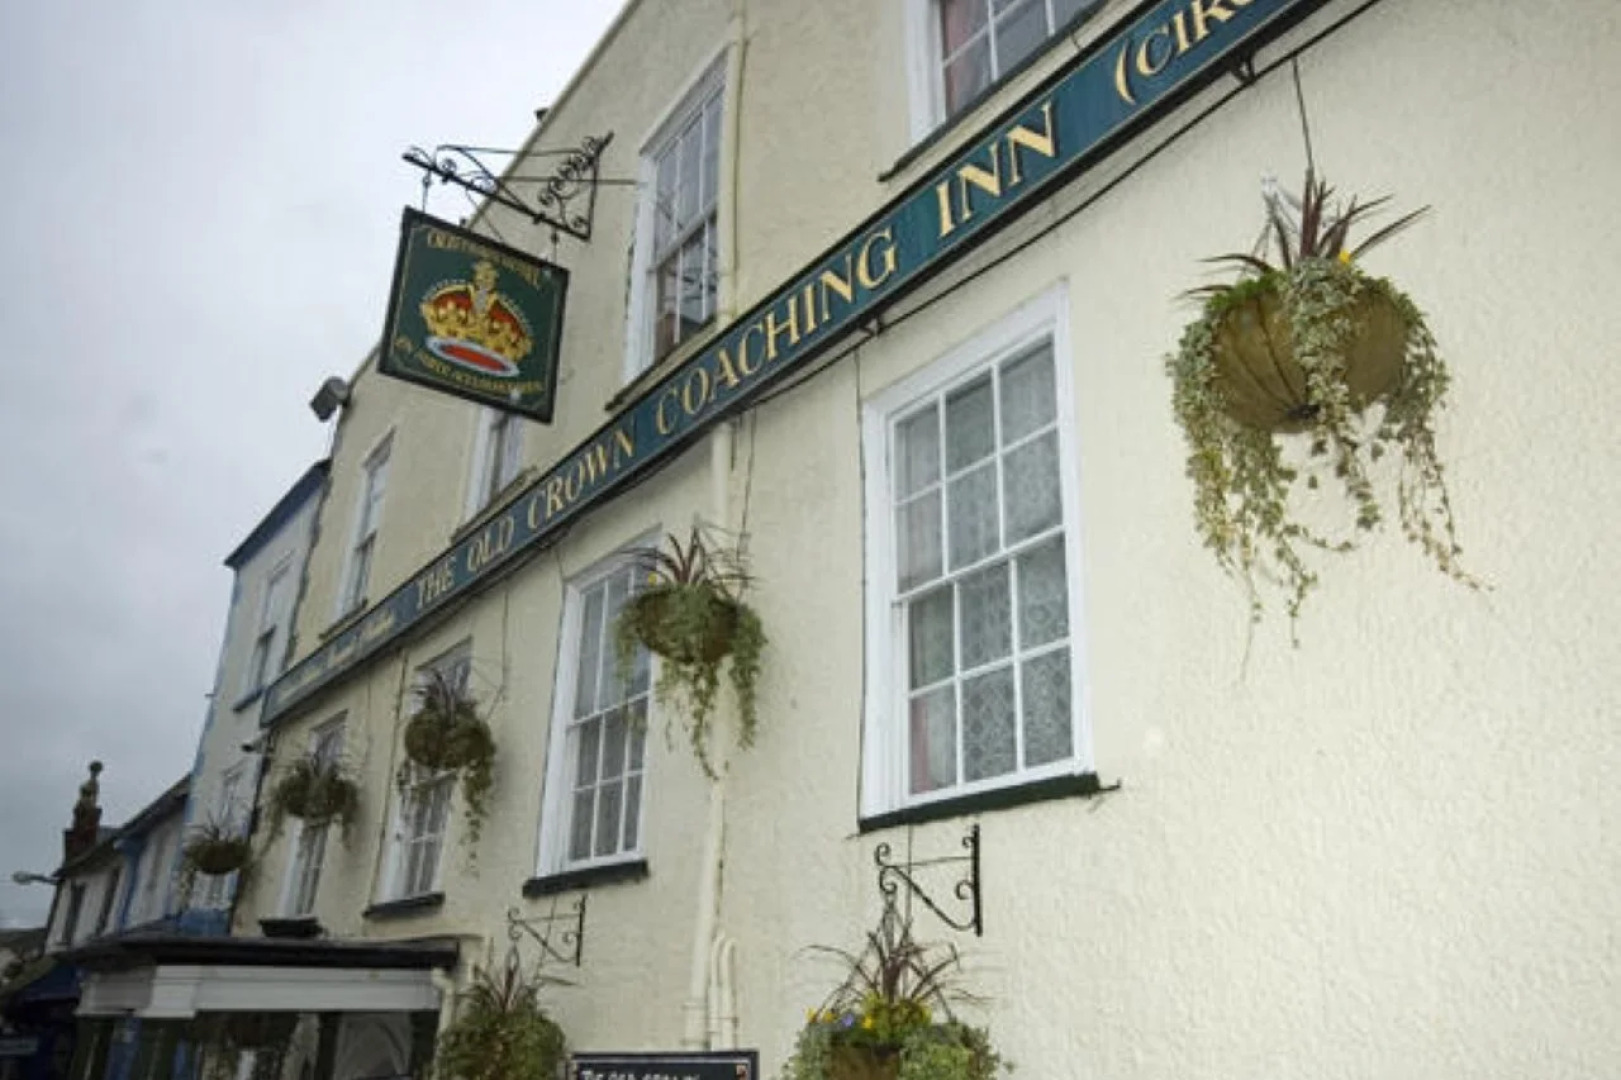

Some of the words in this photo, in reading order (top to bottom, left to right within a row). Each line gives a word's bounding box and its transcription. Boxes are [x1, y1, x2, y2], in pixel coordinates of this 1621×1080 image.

[416, 553, 456, 610] THE
[467, 514, 515, 573] OLD
[527, 410, 635, 530] CROWN
[655, 227, 897, 435] COACHING
[936, 100, 1056, 239] INN
